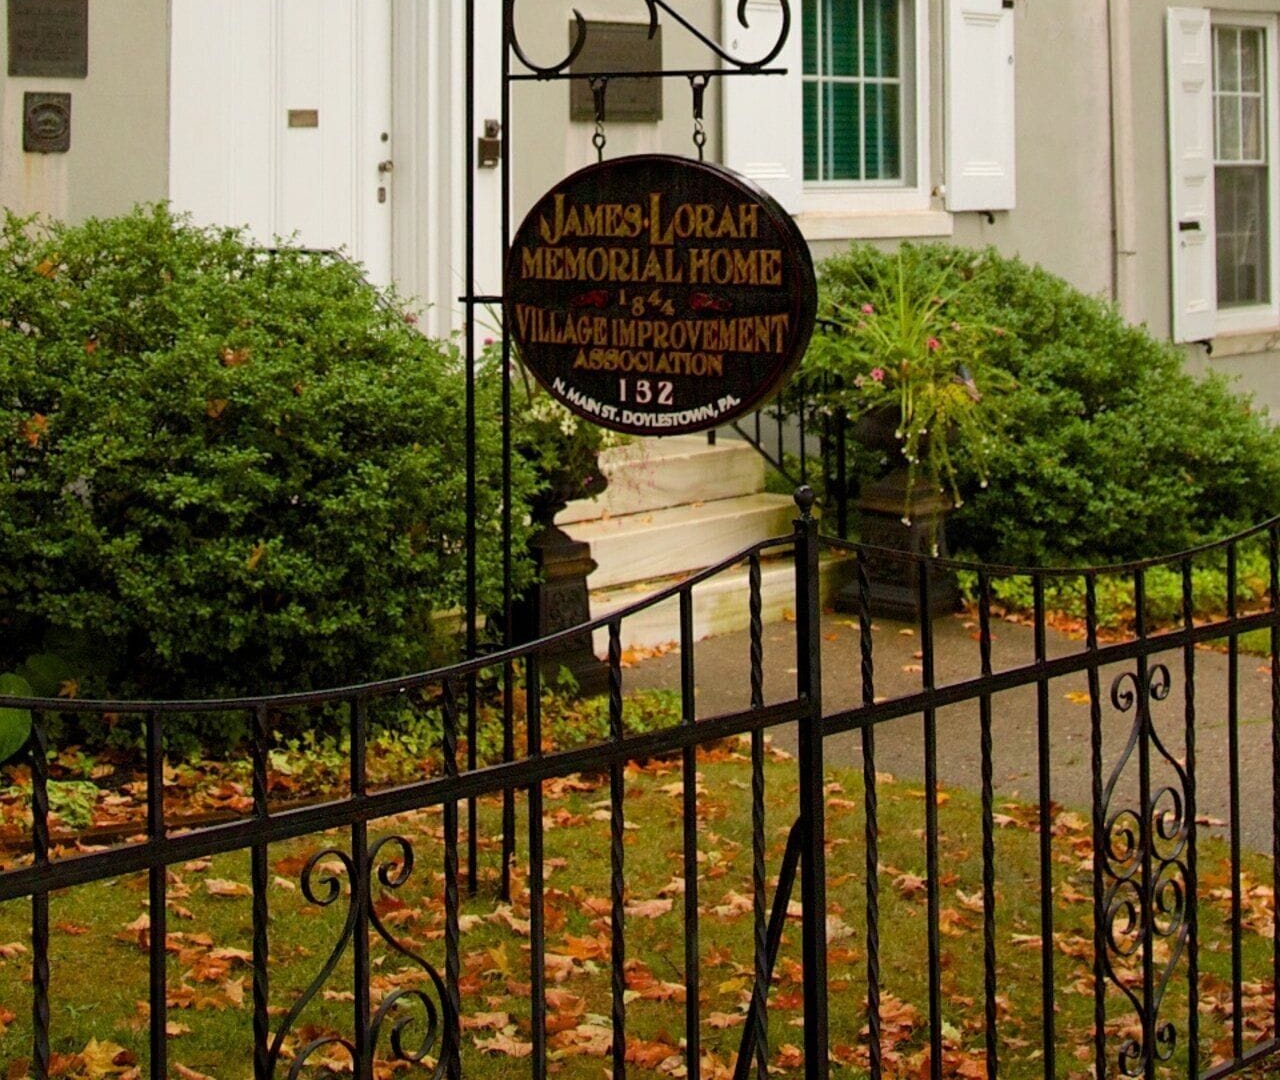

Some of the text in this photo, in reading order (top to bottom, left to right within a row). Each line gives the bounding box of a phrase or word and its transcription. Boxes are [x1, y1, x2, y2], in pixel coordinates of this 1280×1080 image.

[521, 247, 783, 286] MEMORIAL HOME
[618, 288, 676, 317] 1844
[515, 303, 790, 354] VILLAGE IMPROVEMENT
[573, 348, 724, 376] ASSOCIATION
[618, 378, 674, 406] 132
[566, 390, 602, 414] MAIN
[601, 404, 621, 423] ST.
[621, 403, 719, 428] DOYLESTOWN,
